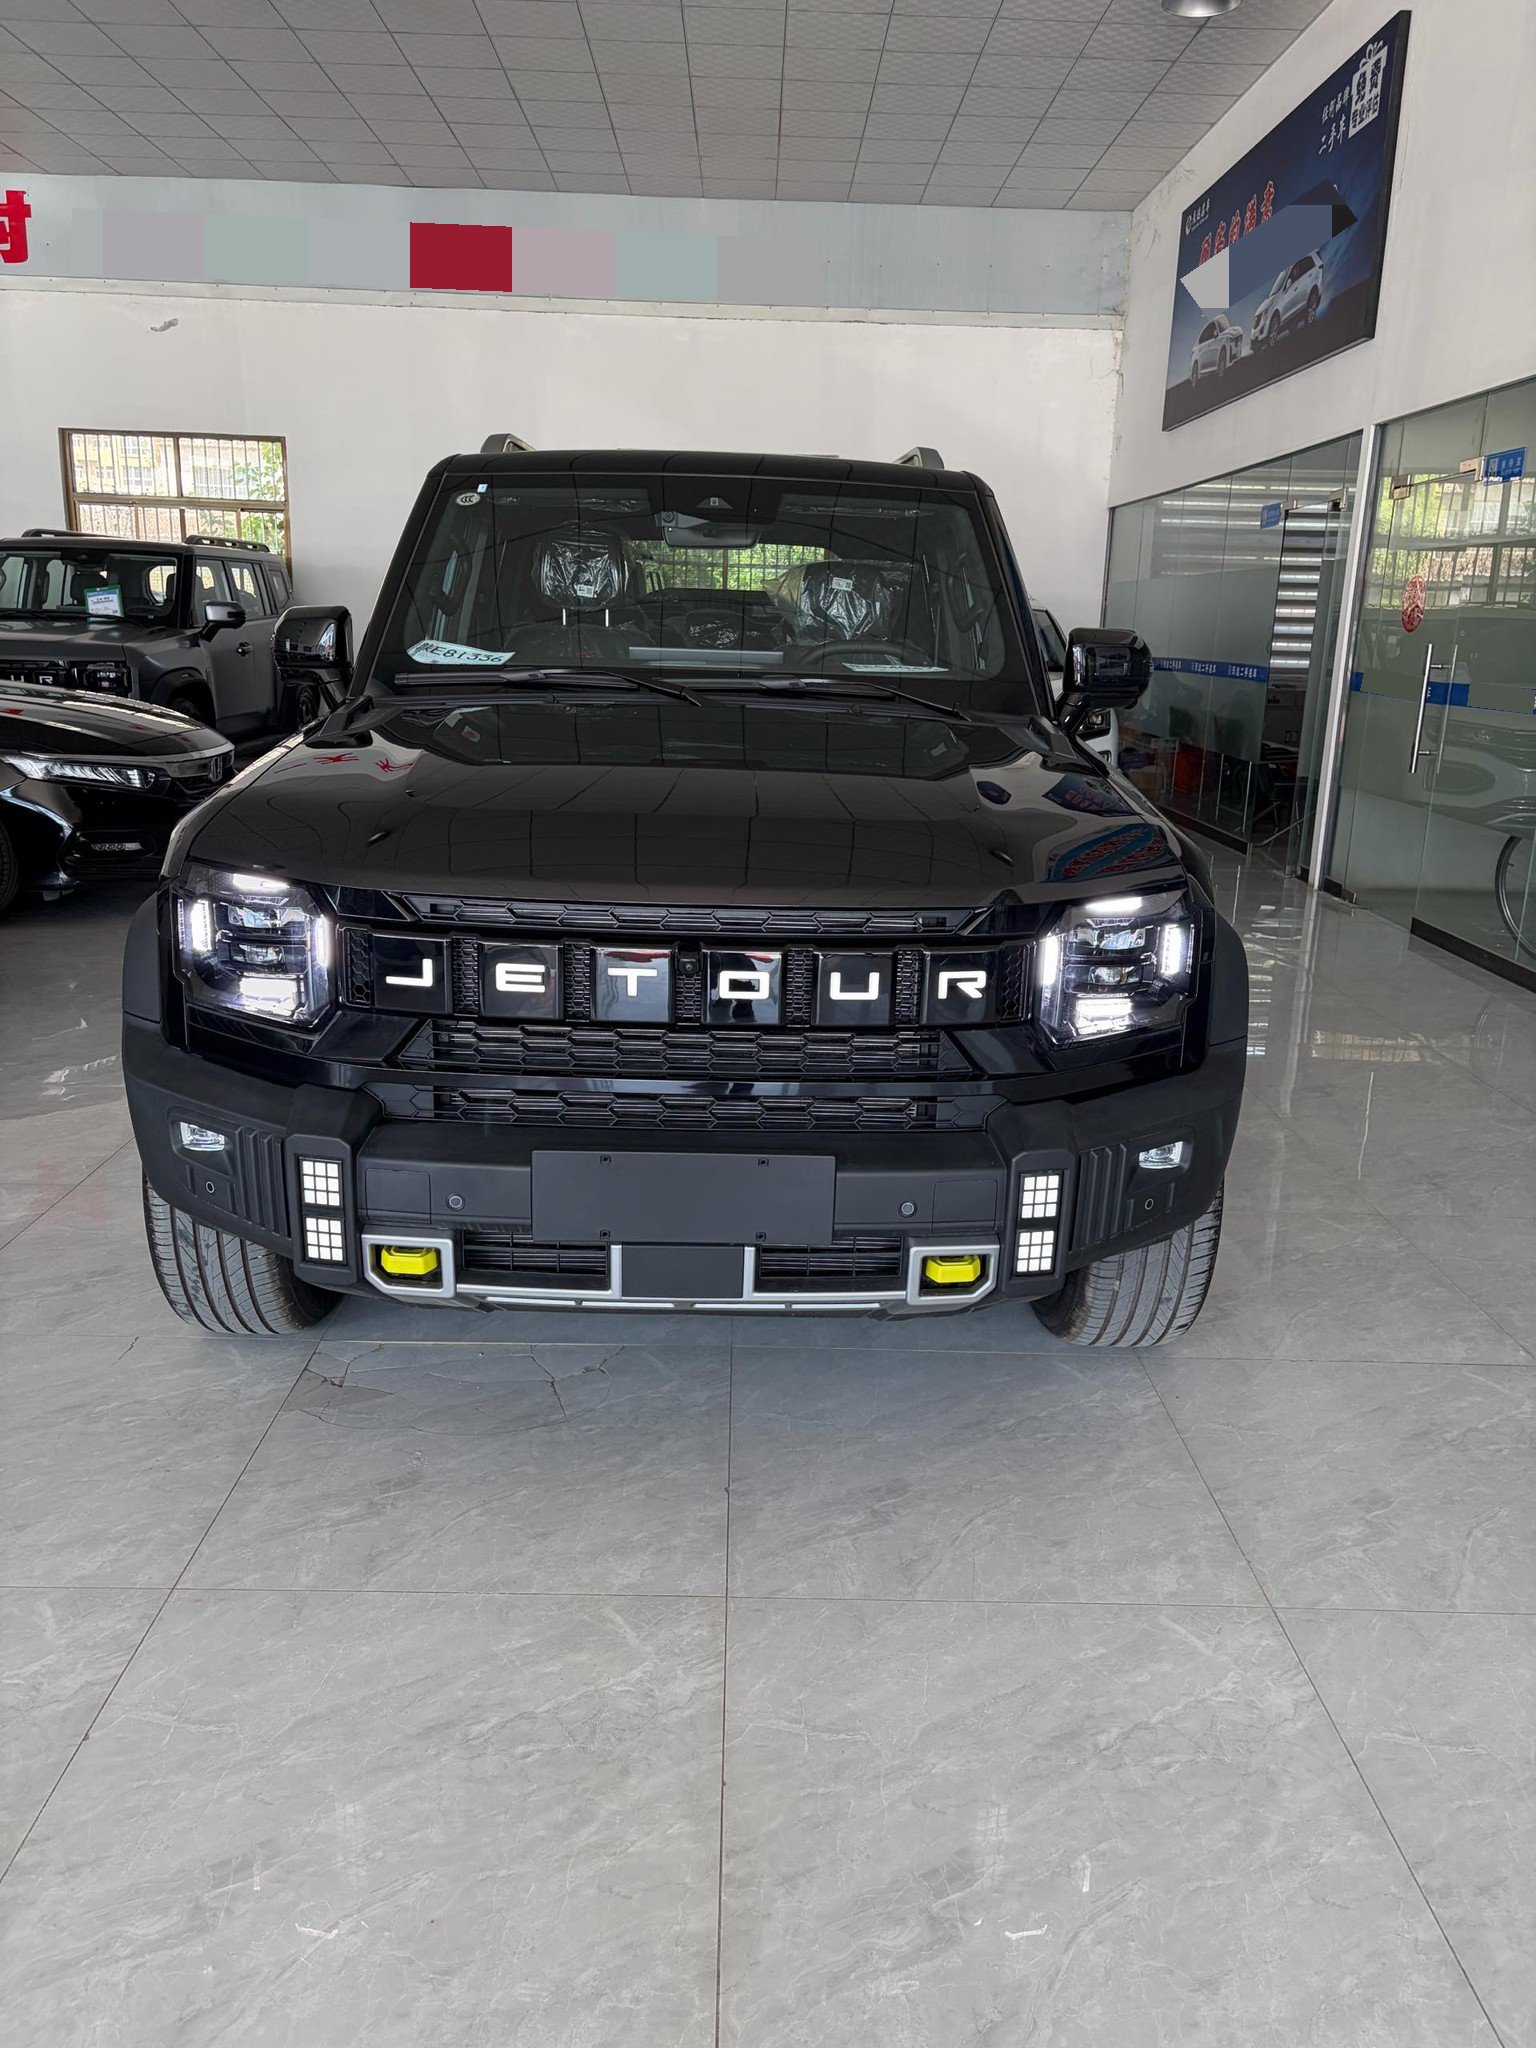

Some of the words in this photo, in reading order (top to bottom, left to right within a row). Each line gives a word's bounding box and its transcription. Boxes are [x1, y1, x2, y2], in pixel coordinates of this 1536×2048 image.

[1355, 57, 1382, 106] 免费
[1352, 90, 1380, 129] 专业评估
[1318, 114, 1346, 155] 二手车
[385, 957, 987, 1001] JETOUR
